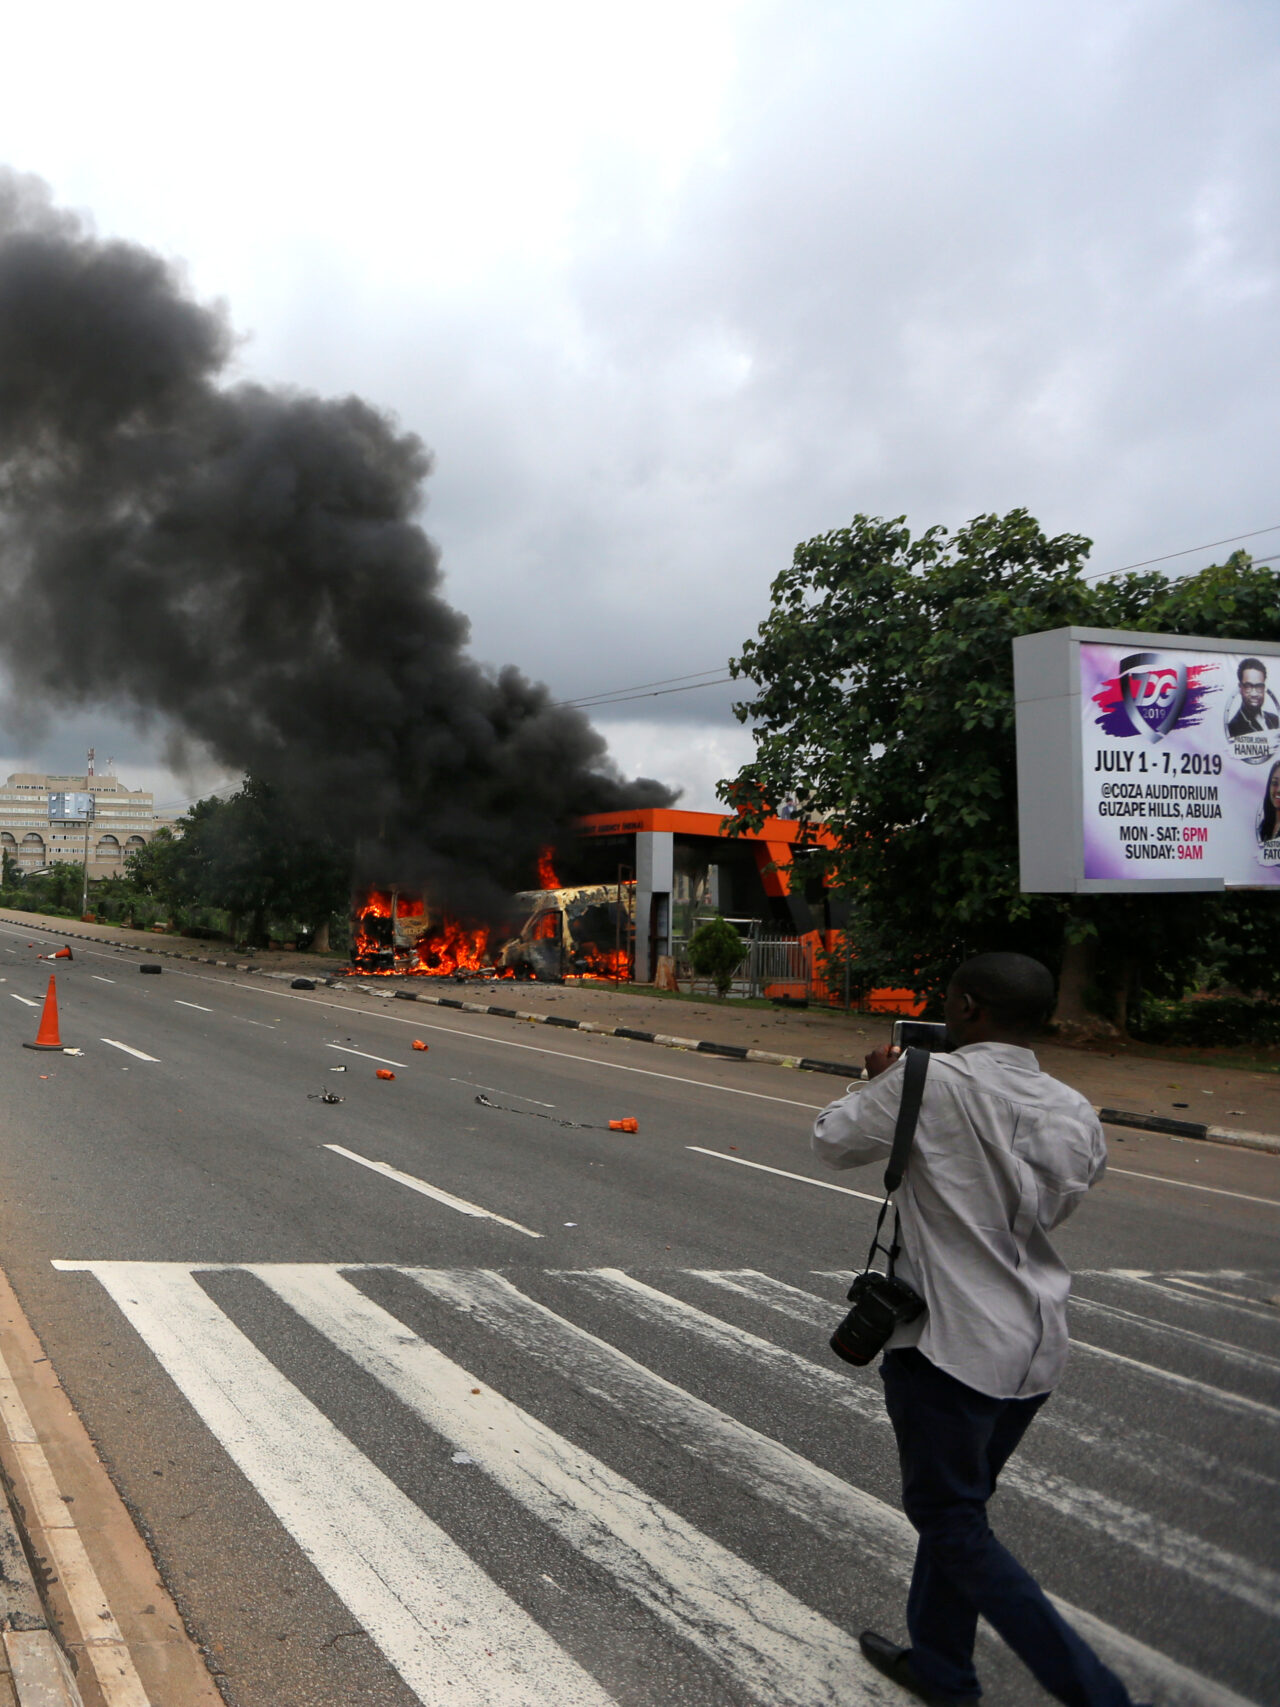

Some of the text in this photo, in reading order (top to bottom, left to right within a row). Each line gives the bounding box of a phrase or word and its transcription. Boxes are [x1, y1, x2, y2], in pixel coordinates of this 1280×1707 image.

[1234, 743, 1270, 756] HANNAH
[1094, 750, 1135, 772] JULY
[1138, 751, 1149, 773] 1
[1162, 752, 1177, 778] 7,
[1181, 753, 1222, 775] 2019
[1101, 782, 1218, 801] @COZA AUDITORIUM
[1098, 801, 1222, 820] GUZAPE HILLS, ABUJA
[1120, 825, 1148, 841] MON
[1156, 826, 1180, 842] SAT:
[1182, 826, 1208, 842] 6PM
[1125, 844, 1203, 860] SUNDAY: 9AM
